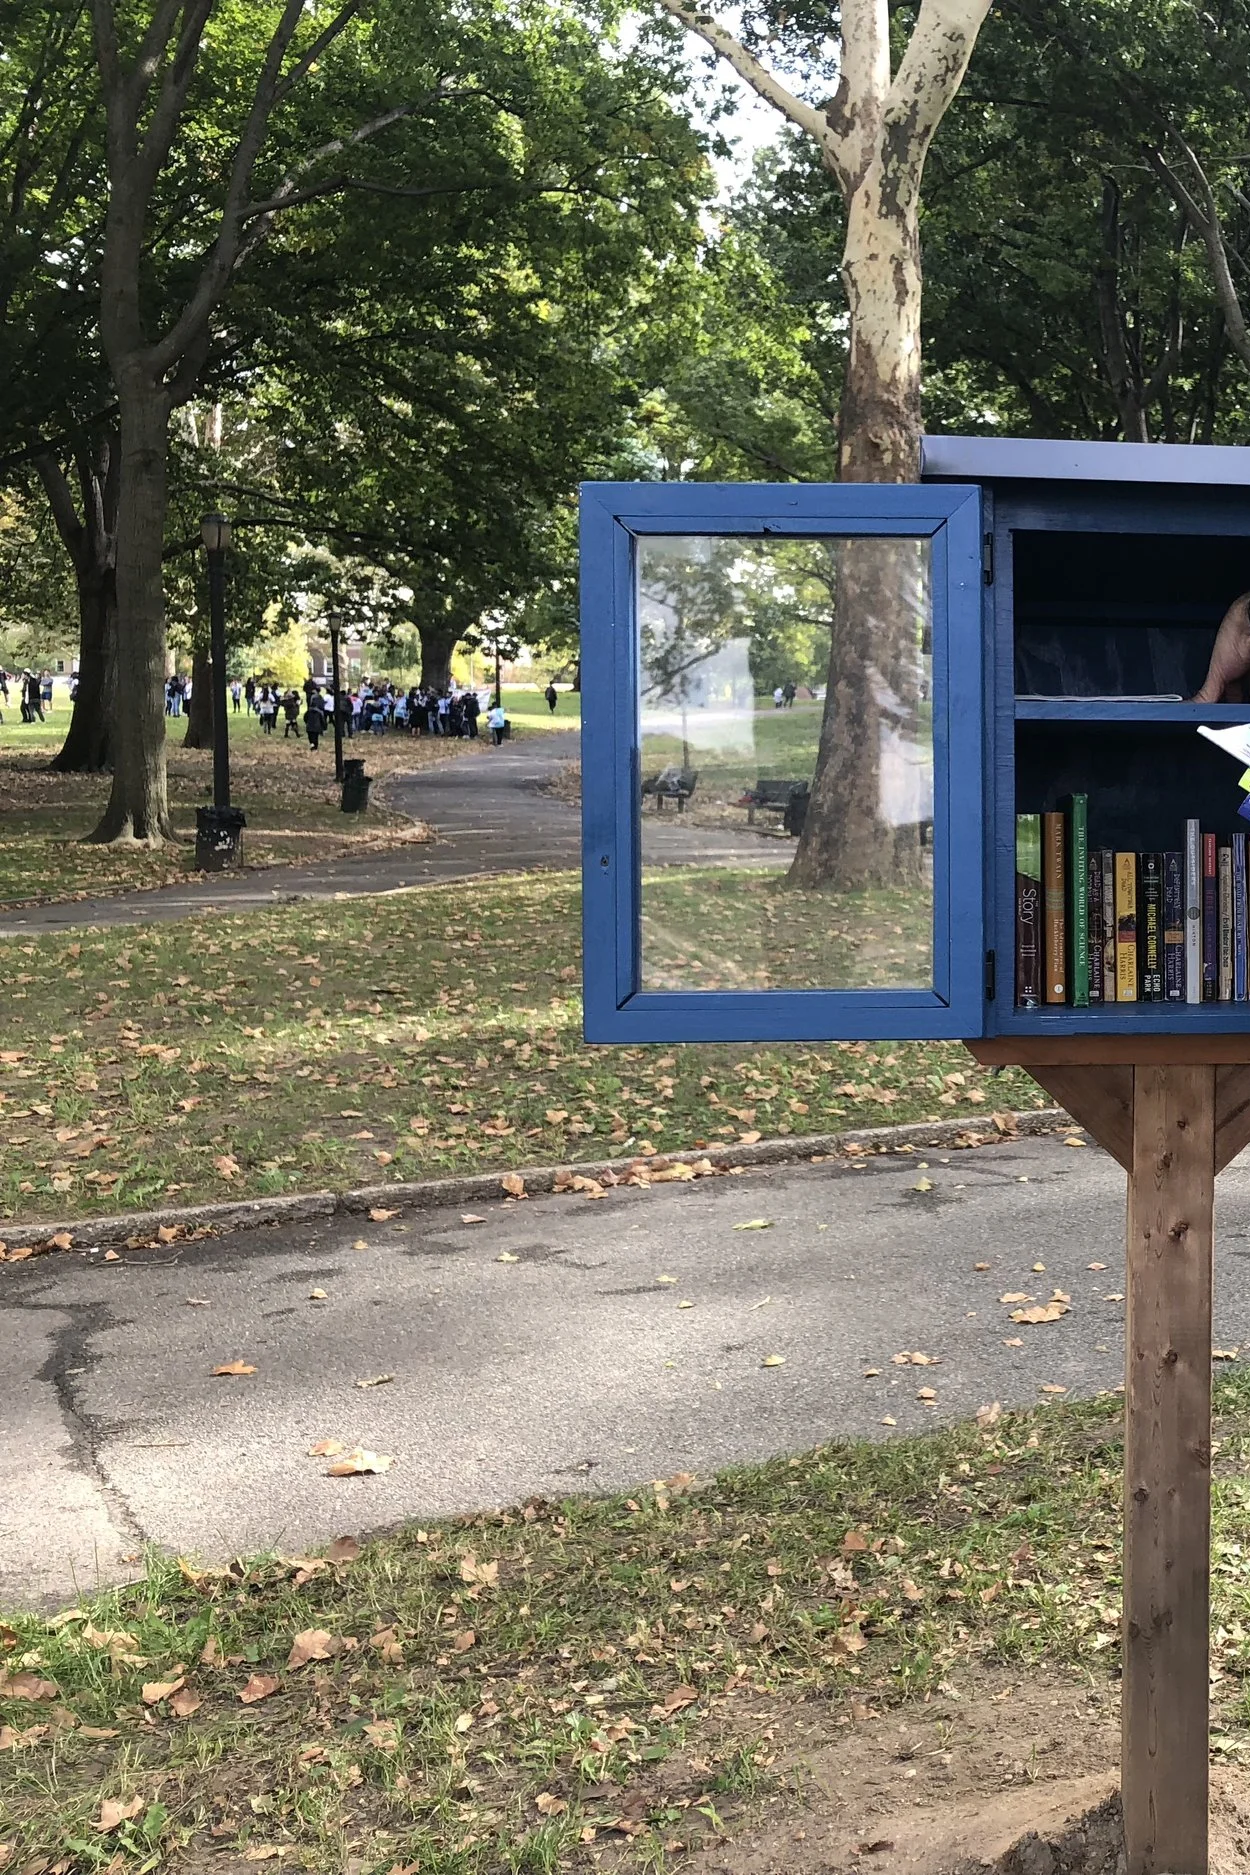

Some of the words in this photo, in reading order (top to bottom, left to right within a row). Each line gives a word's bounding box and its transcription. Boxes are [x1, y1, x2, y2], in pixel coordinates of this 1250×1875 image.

[1055, 851, 1063, 880] TWAIN
[1078, 846, 1086, 883] INVITING
[1019, 888, 1036, 925] Story
[1078, 886, 1086, 916] WORLD
[1078, 919, 1086, 929] OF
[1147, 903, 1157, 934] MICHAEL
[1078, 932, 1086, 967] SCIENCE
[1147, 935, 1157, 970] CONNELLY
[1093, 944, 1102, 989] CHARLAINE
[1119, 952, 1128, 980] HARRIS
[1127, 944, 1135, 988] CHARLAINE
[1166, 952, 1175, 980] HARRIS
[1174, 944, 1182, 988] CHARLAINE
[1144, 974, 1152, 993] PARK
[1152, 974, 1161, 992] ECHO
